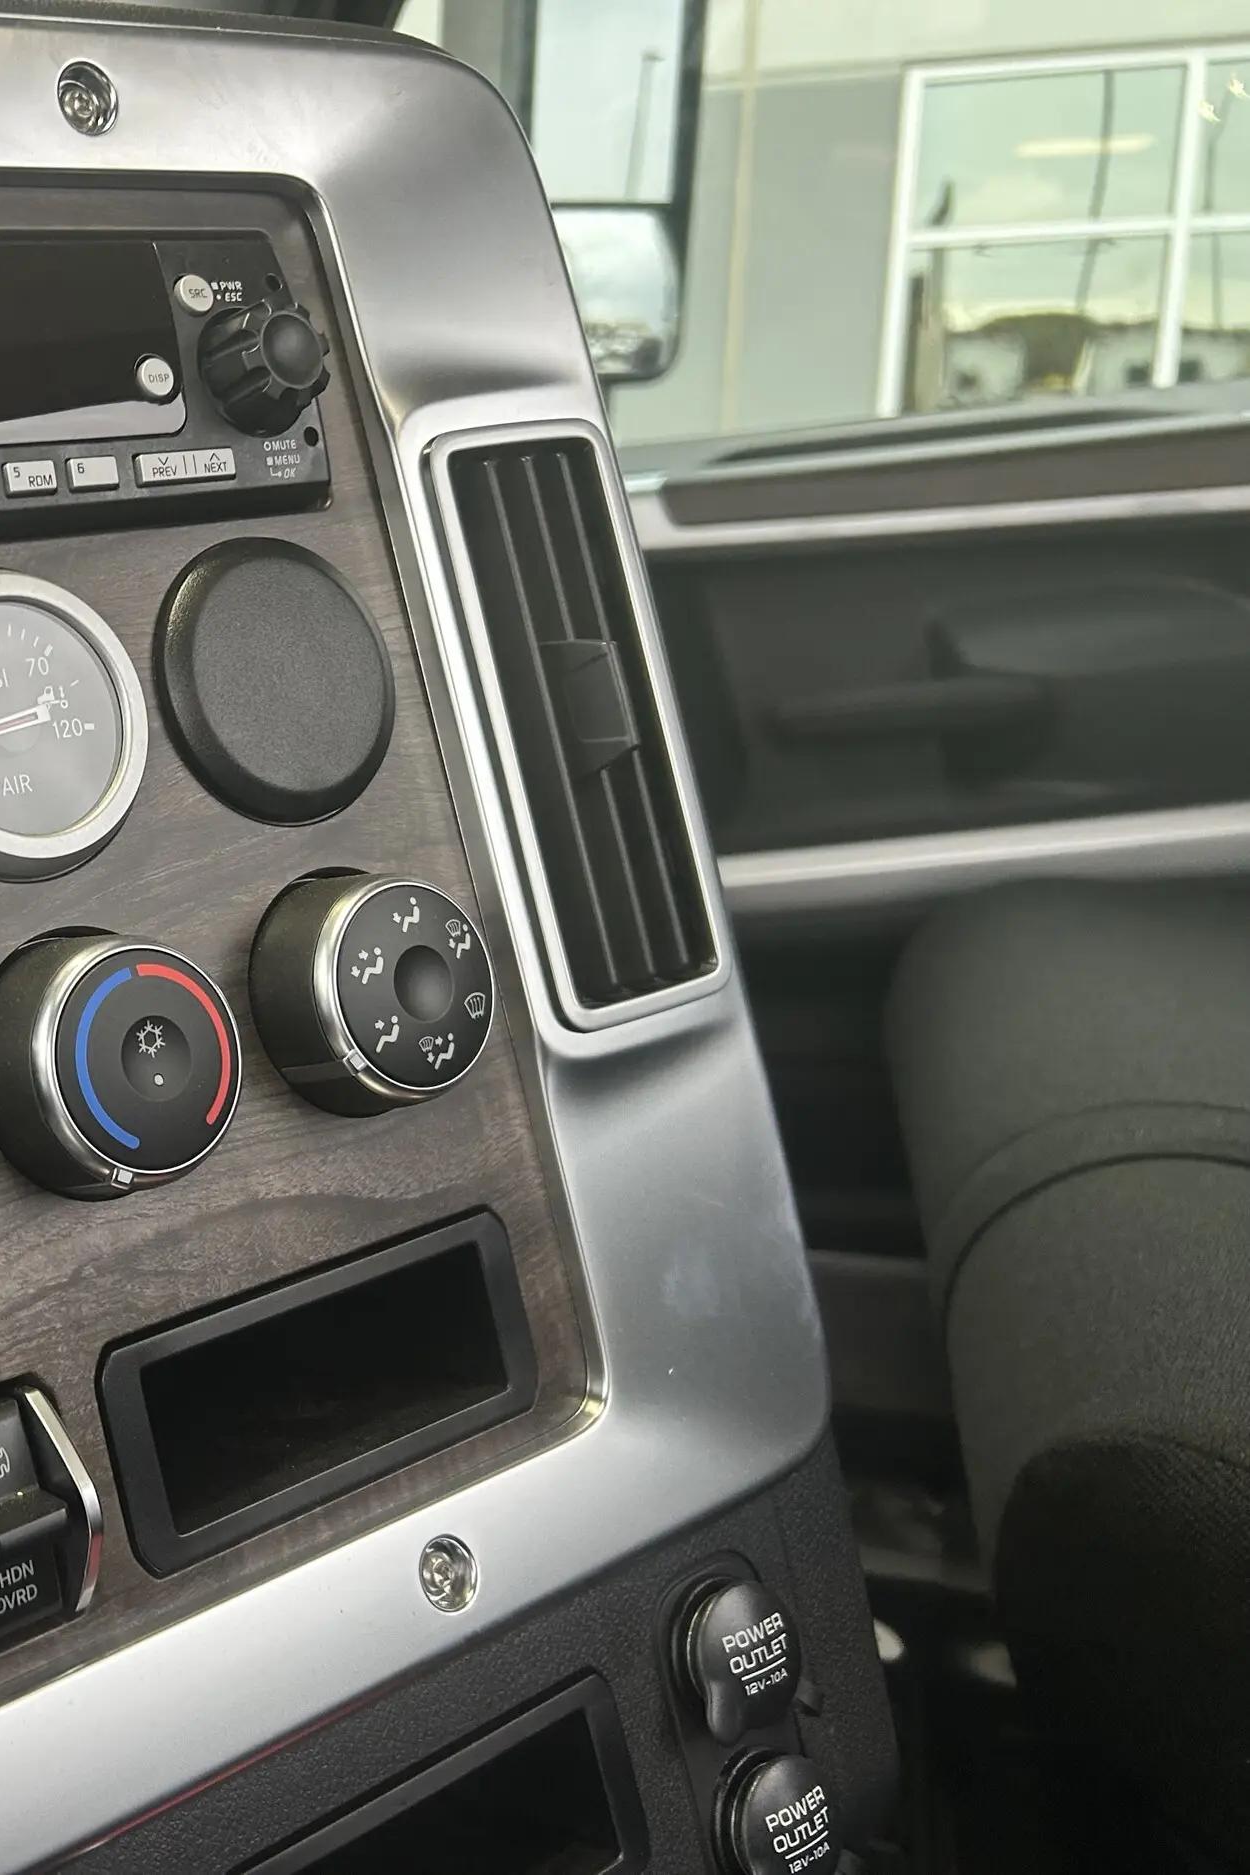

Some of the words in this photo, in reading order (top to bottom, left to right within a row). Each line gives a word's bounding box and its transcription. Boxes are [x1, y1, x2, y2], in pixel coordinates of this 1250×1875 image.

[219, 280, 243, 291] PWR
[188, 288, 208, 299] SRC
[224, 292, 243, 302] ESC
[148, 373, 170, 384] DISP
[271, 440, 297, 451] MUTE
[273, 454, 300, 465] MENU
[13, 466, 21, 479] 5
[77, 462, 85, 475] 6
[152, 464, 178, 478] PREV
[204, 462, 229, 474] NEXT
[284, 468, 297, 479] OK
[28, 474, 54, 488] RDM
[26, 656, 49, 678] 70
[52, 718, 83, 740] 120
[2, 774, 33, 797] AIR
[721, 1611, 785, 1654] POWER
[728, 1632, 789, 1675] OUTLET
[744, 1667, 789, 1697] 12V-10A
[764, 1785, 826, 1833] POWER
[772, 1805, 830, 1854] OUTLET
[788, 1841, 831, 1875] 12V-10A
